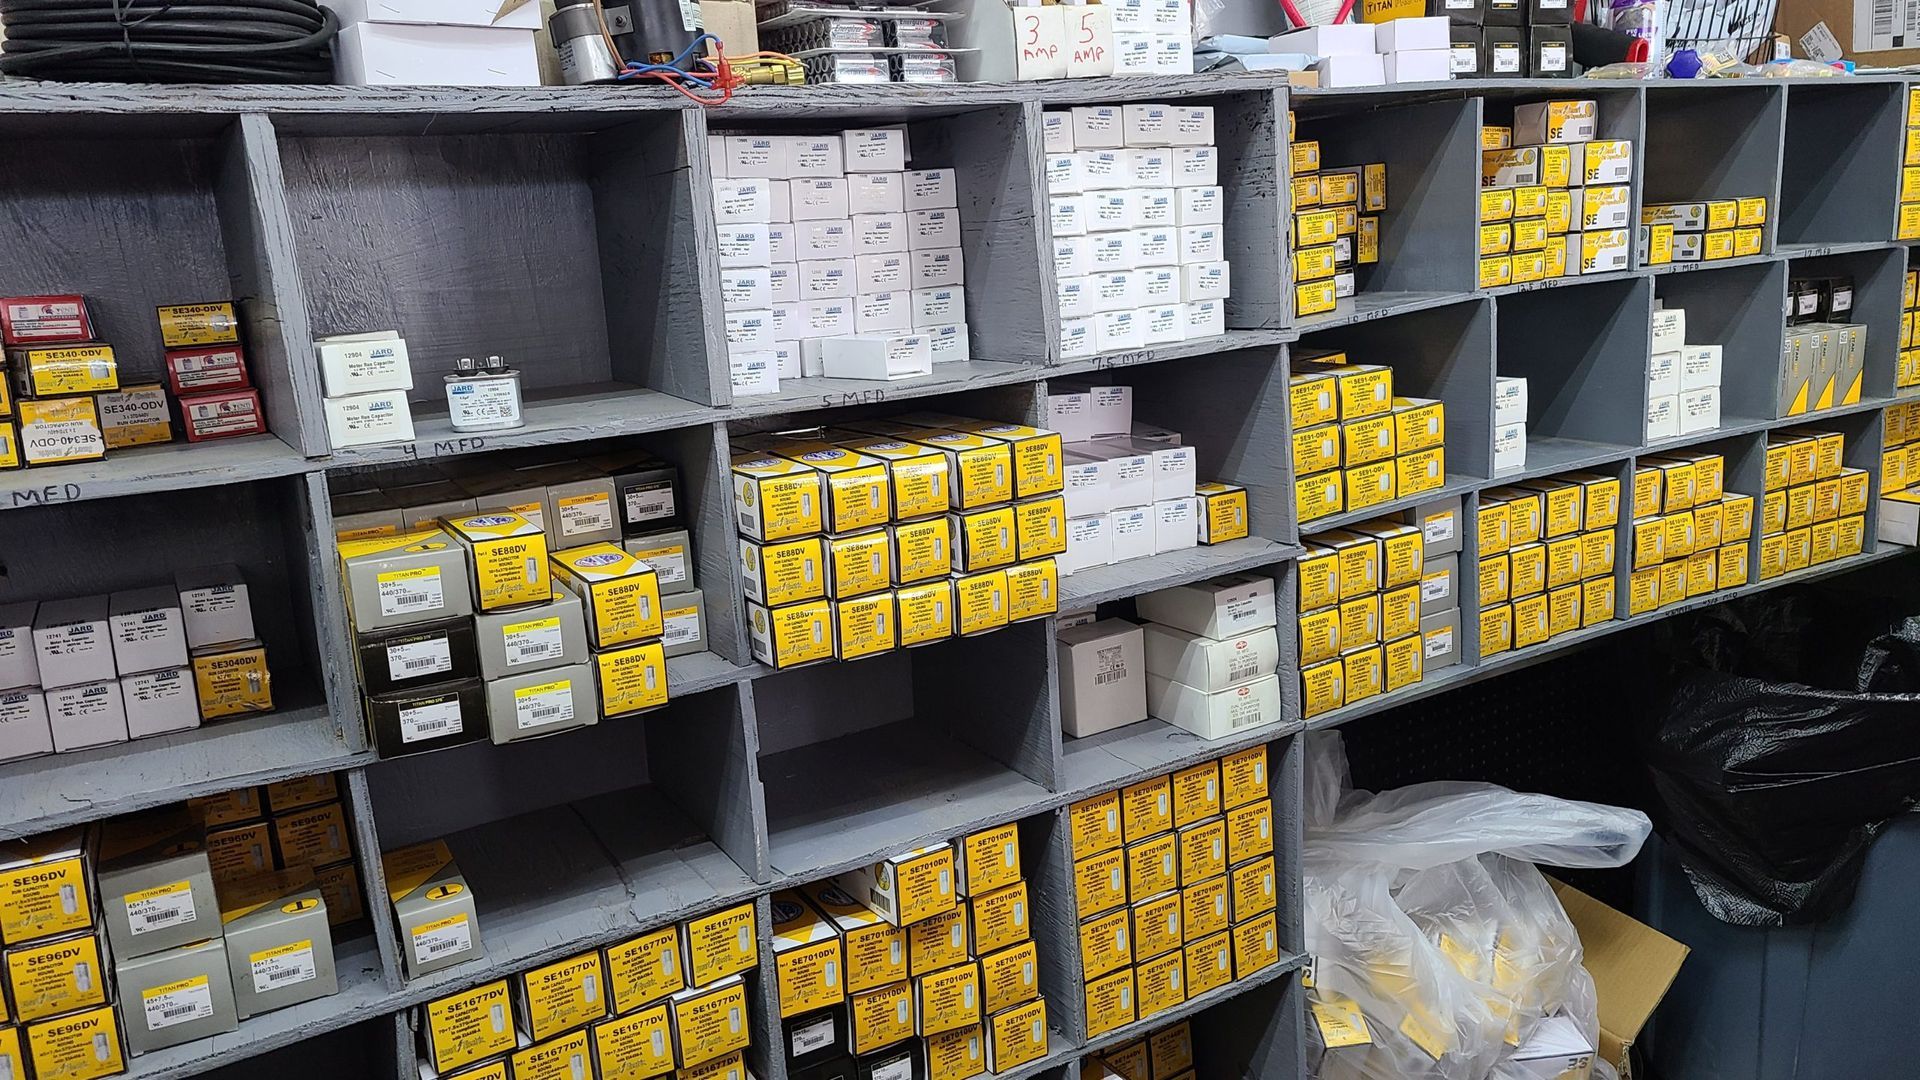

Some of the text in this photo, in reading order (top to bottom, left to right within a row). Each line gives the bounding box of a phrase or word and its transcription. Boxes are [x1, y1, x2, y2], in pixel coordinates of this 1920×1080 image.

[1366, 2, 1392, 14] TITAN
[1025, 16, 1040, 45] 3
[1080, 13, 1094, 43] 5
[1024, 45, 1058, 61] AMP
[1074, 47, 1104, 63] AMP
[1550, 128, 1563, 139] SE
[1588, 169, 1599, 179] SE
[1586, 214, 1597, 225] SE
[1584, 259, 1596, 268] SE
[172, 305, 222, 314] SE340-ODV
[45, 349, 102, 359] SE340-ODV
[821, 389, 885, 408] 5 MFD
[104, 401, 164, 414] SE340-ODV
[30, 435, 96, 448] SE340-ODV
[403, 437, 484, 459] 4 MFD
[1026, 443, 1048, 453] SE88DV
[972, 453, 996, 463] SE88DV
[13, 483, 81, 506] MFD
[1028, 507, 1051, 516] SE88DV
[977, 517, 1001, 527] SE88DV
[910, 528, 935, 538] SE88DV
[491, 545, 526, 557] SE88DV
[776, 548, 805, 559] SE88DV
[608, 583, 640, 596] SE88DV
[786, 611, 814, 621] SE88DV
[852, 603, 878, 614] SE88DV
[68, 625, 93, 633] JARD
[211, 657, 258, 669] SE3040DV
[614, 654, 647, 667] SE88DV
[1232, 752, 1263, 766] SE7010DV
[1081, 797, 1115, 813] SE7010DV
[978, 830, 1014, 847] SE7010DV
[1191, 827, 1222, 842] SE7010DV
[910, 857, 949, 875] SE7010DV
[1242, 863, 1271, 879] SE7010DV
[13, 869, 67, 887] SE96DV
[986, 889, 1022, 907] SE7010DV
[704, 910, 752, 933] SE1677DV
[624, 934, 674, 958] SE1677DV
[28, 947, 81, 966] SE96DV
[791, 948, 835, 967] SE7010DV
[996, 949, 1032, 967] SE7010DV
[543, 959, 597, 984] SE1677DV
[935, 971, 974, 988] SE7010DV
[1096, 975, 1130, 992] SE7010DV
[447, 988, 504, 1013] SE1677DV
[867, 986, 907, 1005] SE7010DV
[1005, 1007, 1041, 1026] SE7010DV
[48, 1018, 99, 1038] SE96DV
[612, 1013, 665, 1038] SE1677DV
[530, 1038, 584, 1064] SE1677DV
